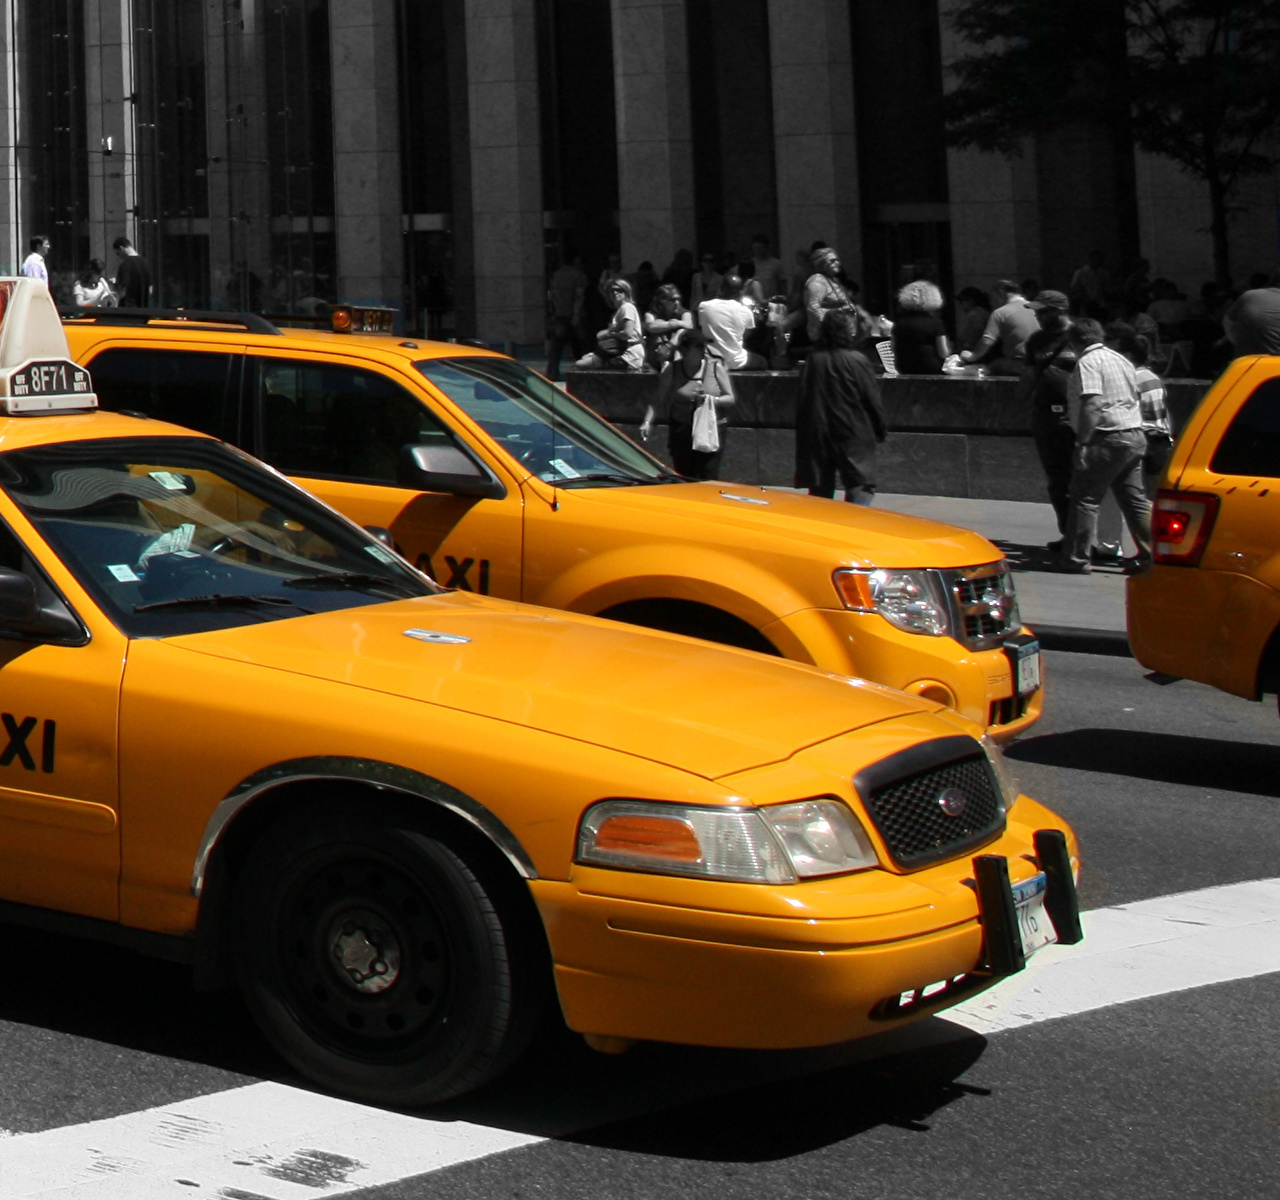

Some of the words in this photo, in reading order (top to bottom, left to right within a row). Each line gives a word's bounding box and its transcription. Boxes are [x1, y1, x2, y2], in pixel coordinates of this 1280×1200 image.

[31, 364, 68, 393] 8F71
[72, 381, 87, 393] DUTY
[14, 384, 29, 396] DUTY
[414, 553, 490, 596] AXI
